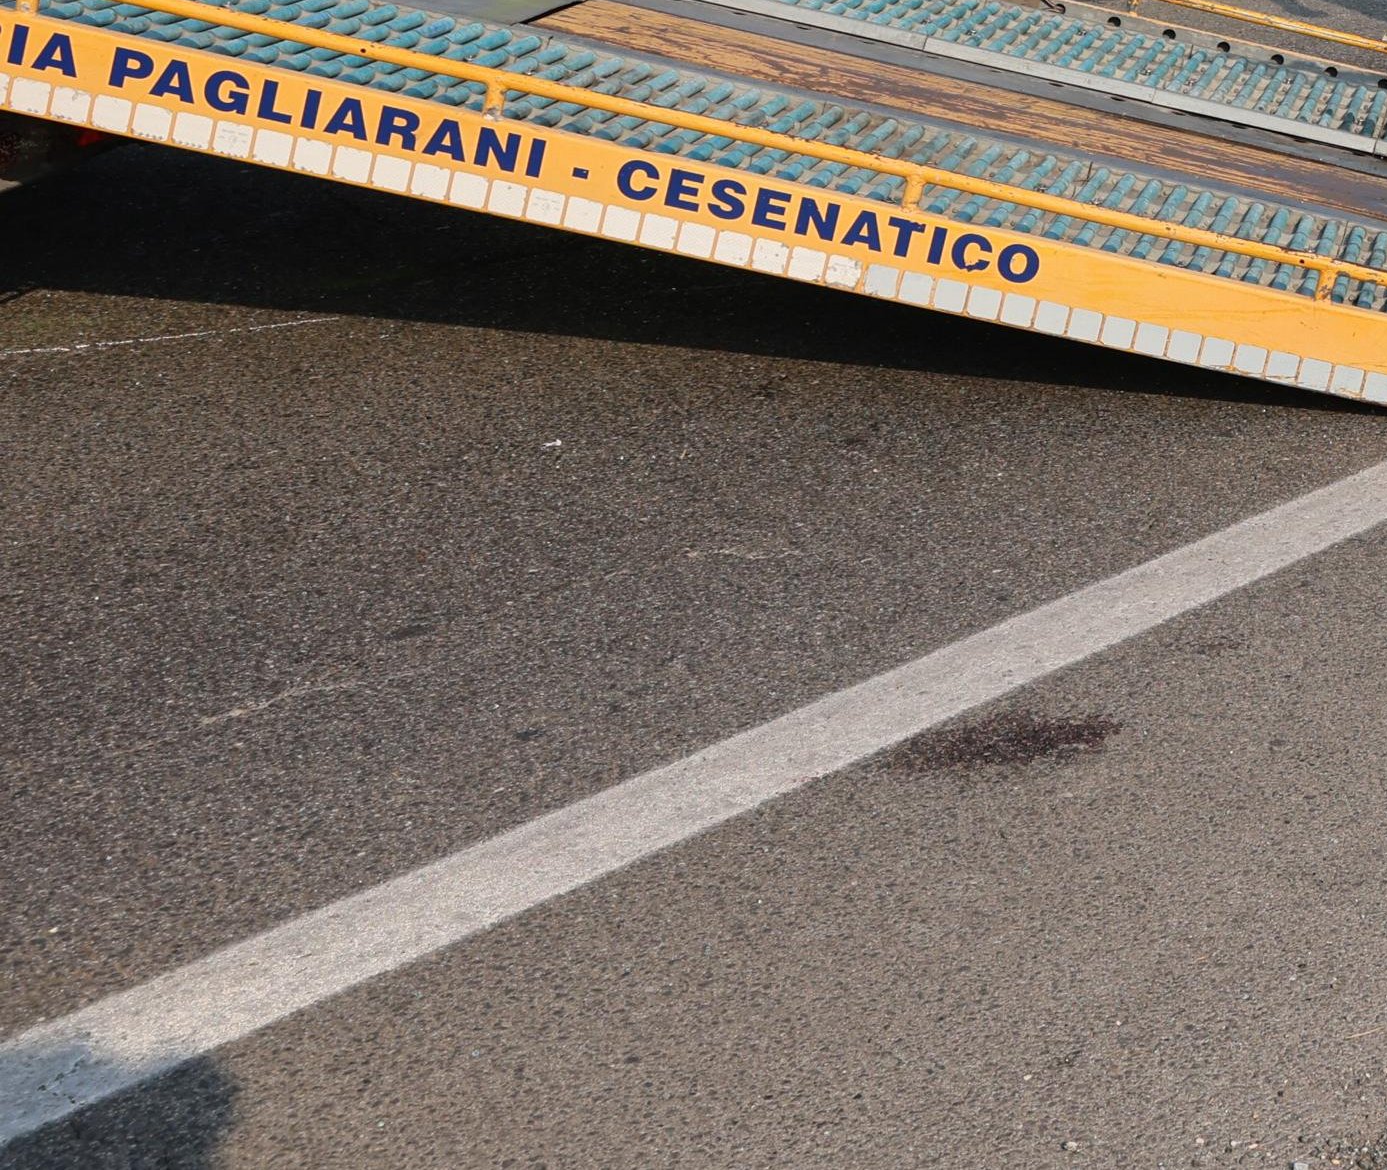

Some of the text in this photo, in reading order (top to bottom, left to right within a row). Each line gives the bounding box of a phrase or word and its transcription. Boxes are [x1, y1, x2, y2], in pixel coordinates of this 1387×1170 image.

[0, 22, 1041, 284] IA PAGLIARANI - CESENATICO
